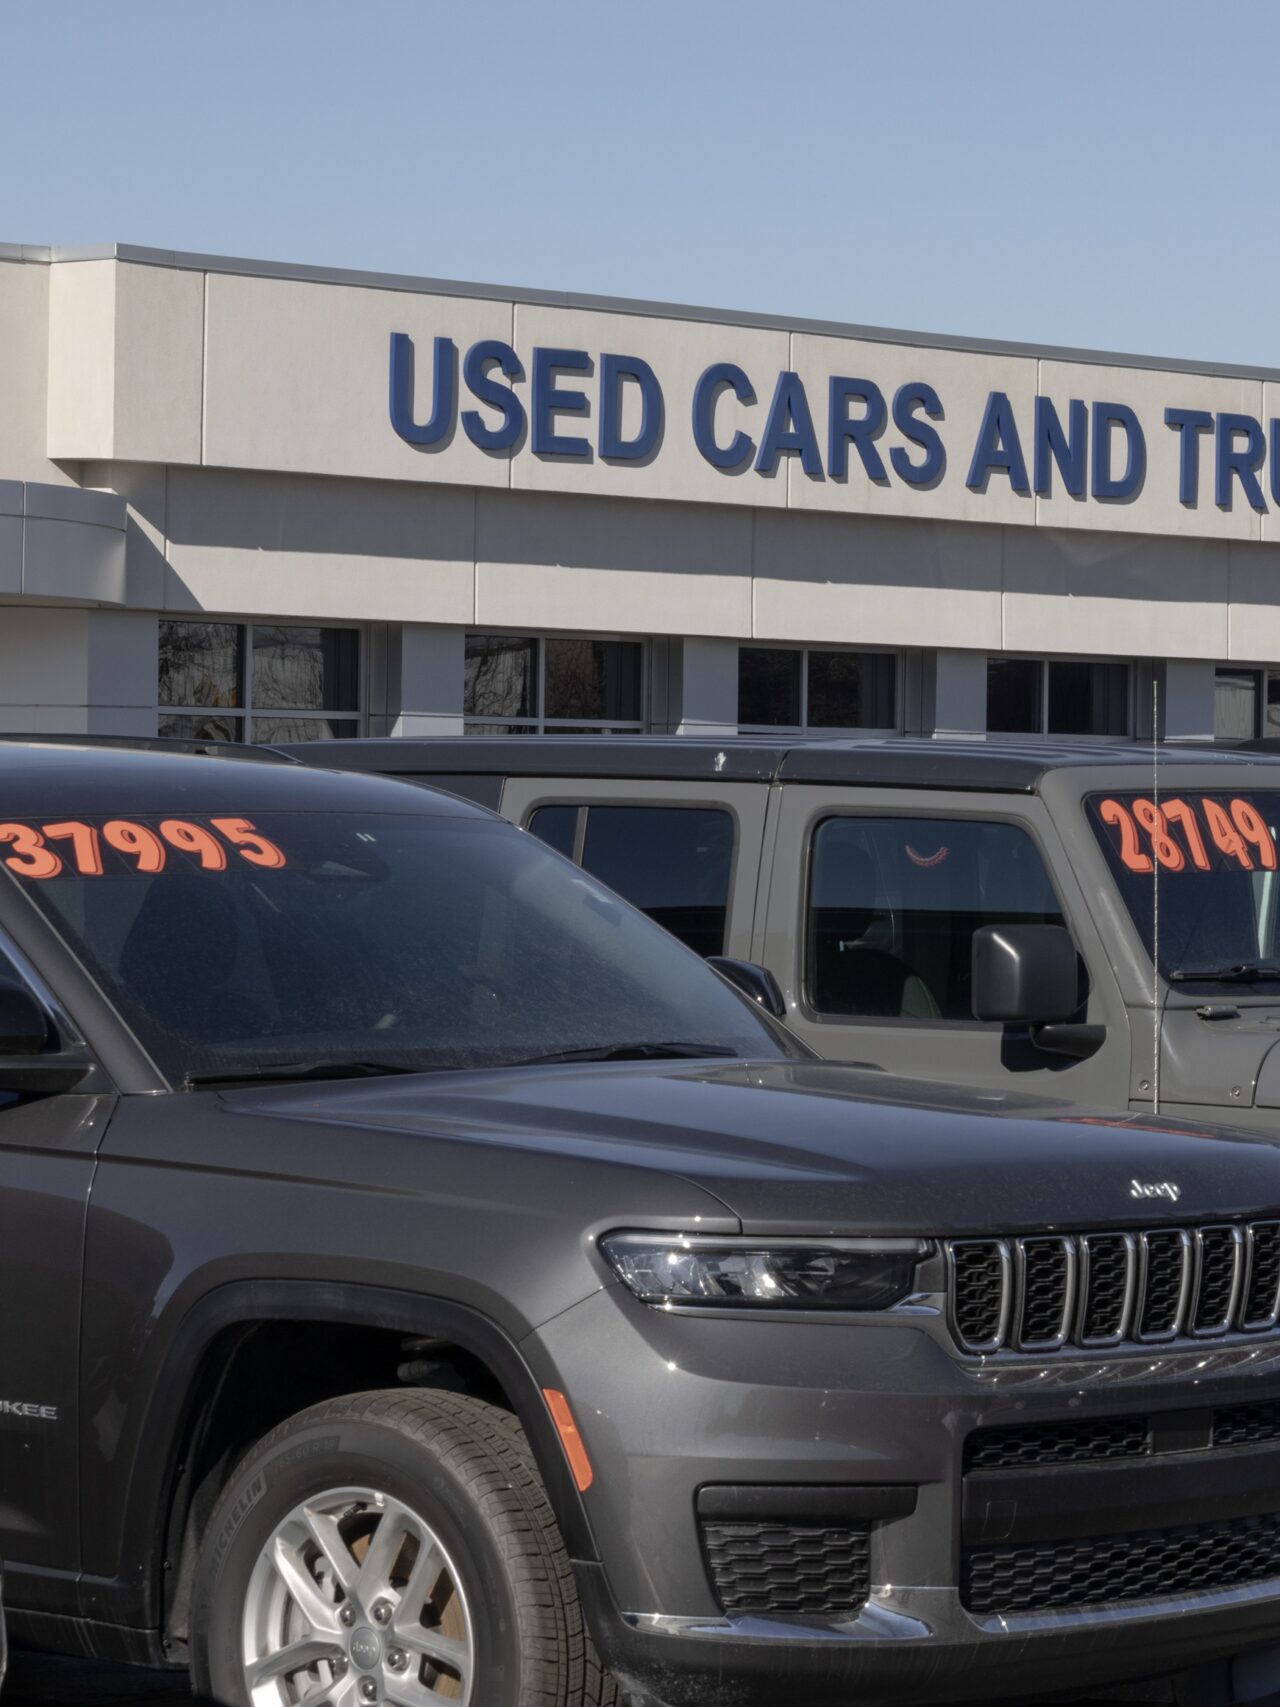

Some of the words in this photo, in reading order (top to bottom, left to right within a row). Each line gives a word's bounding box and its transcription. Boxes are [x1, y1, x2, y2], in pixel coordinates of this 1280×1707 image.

[389, 332, 663, 461] USED
[692, 362, 946, 485] CARS
[965, 390, 1147, 500] AND
[0, 818, 287, 879] 37995
[1100, 798, 1277, 873] 28749
[1130, 1179, 1181, 1202] Jeep
[0, 1399, 58, 1420] KEE
